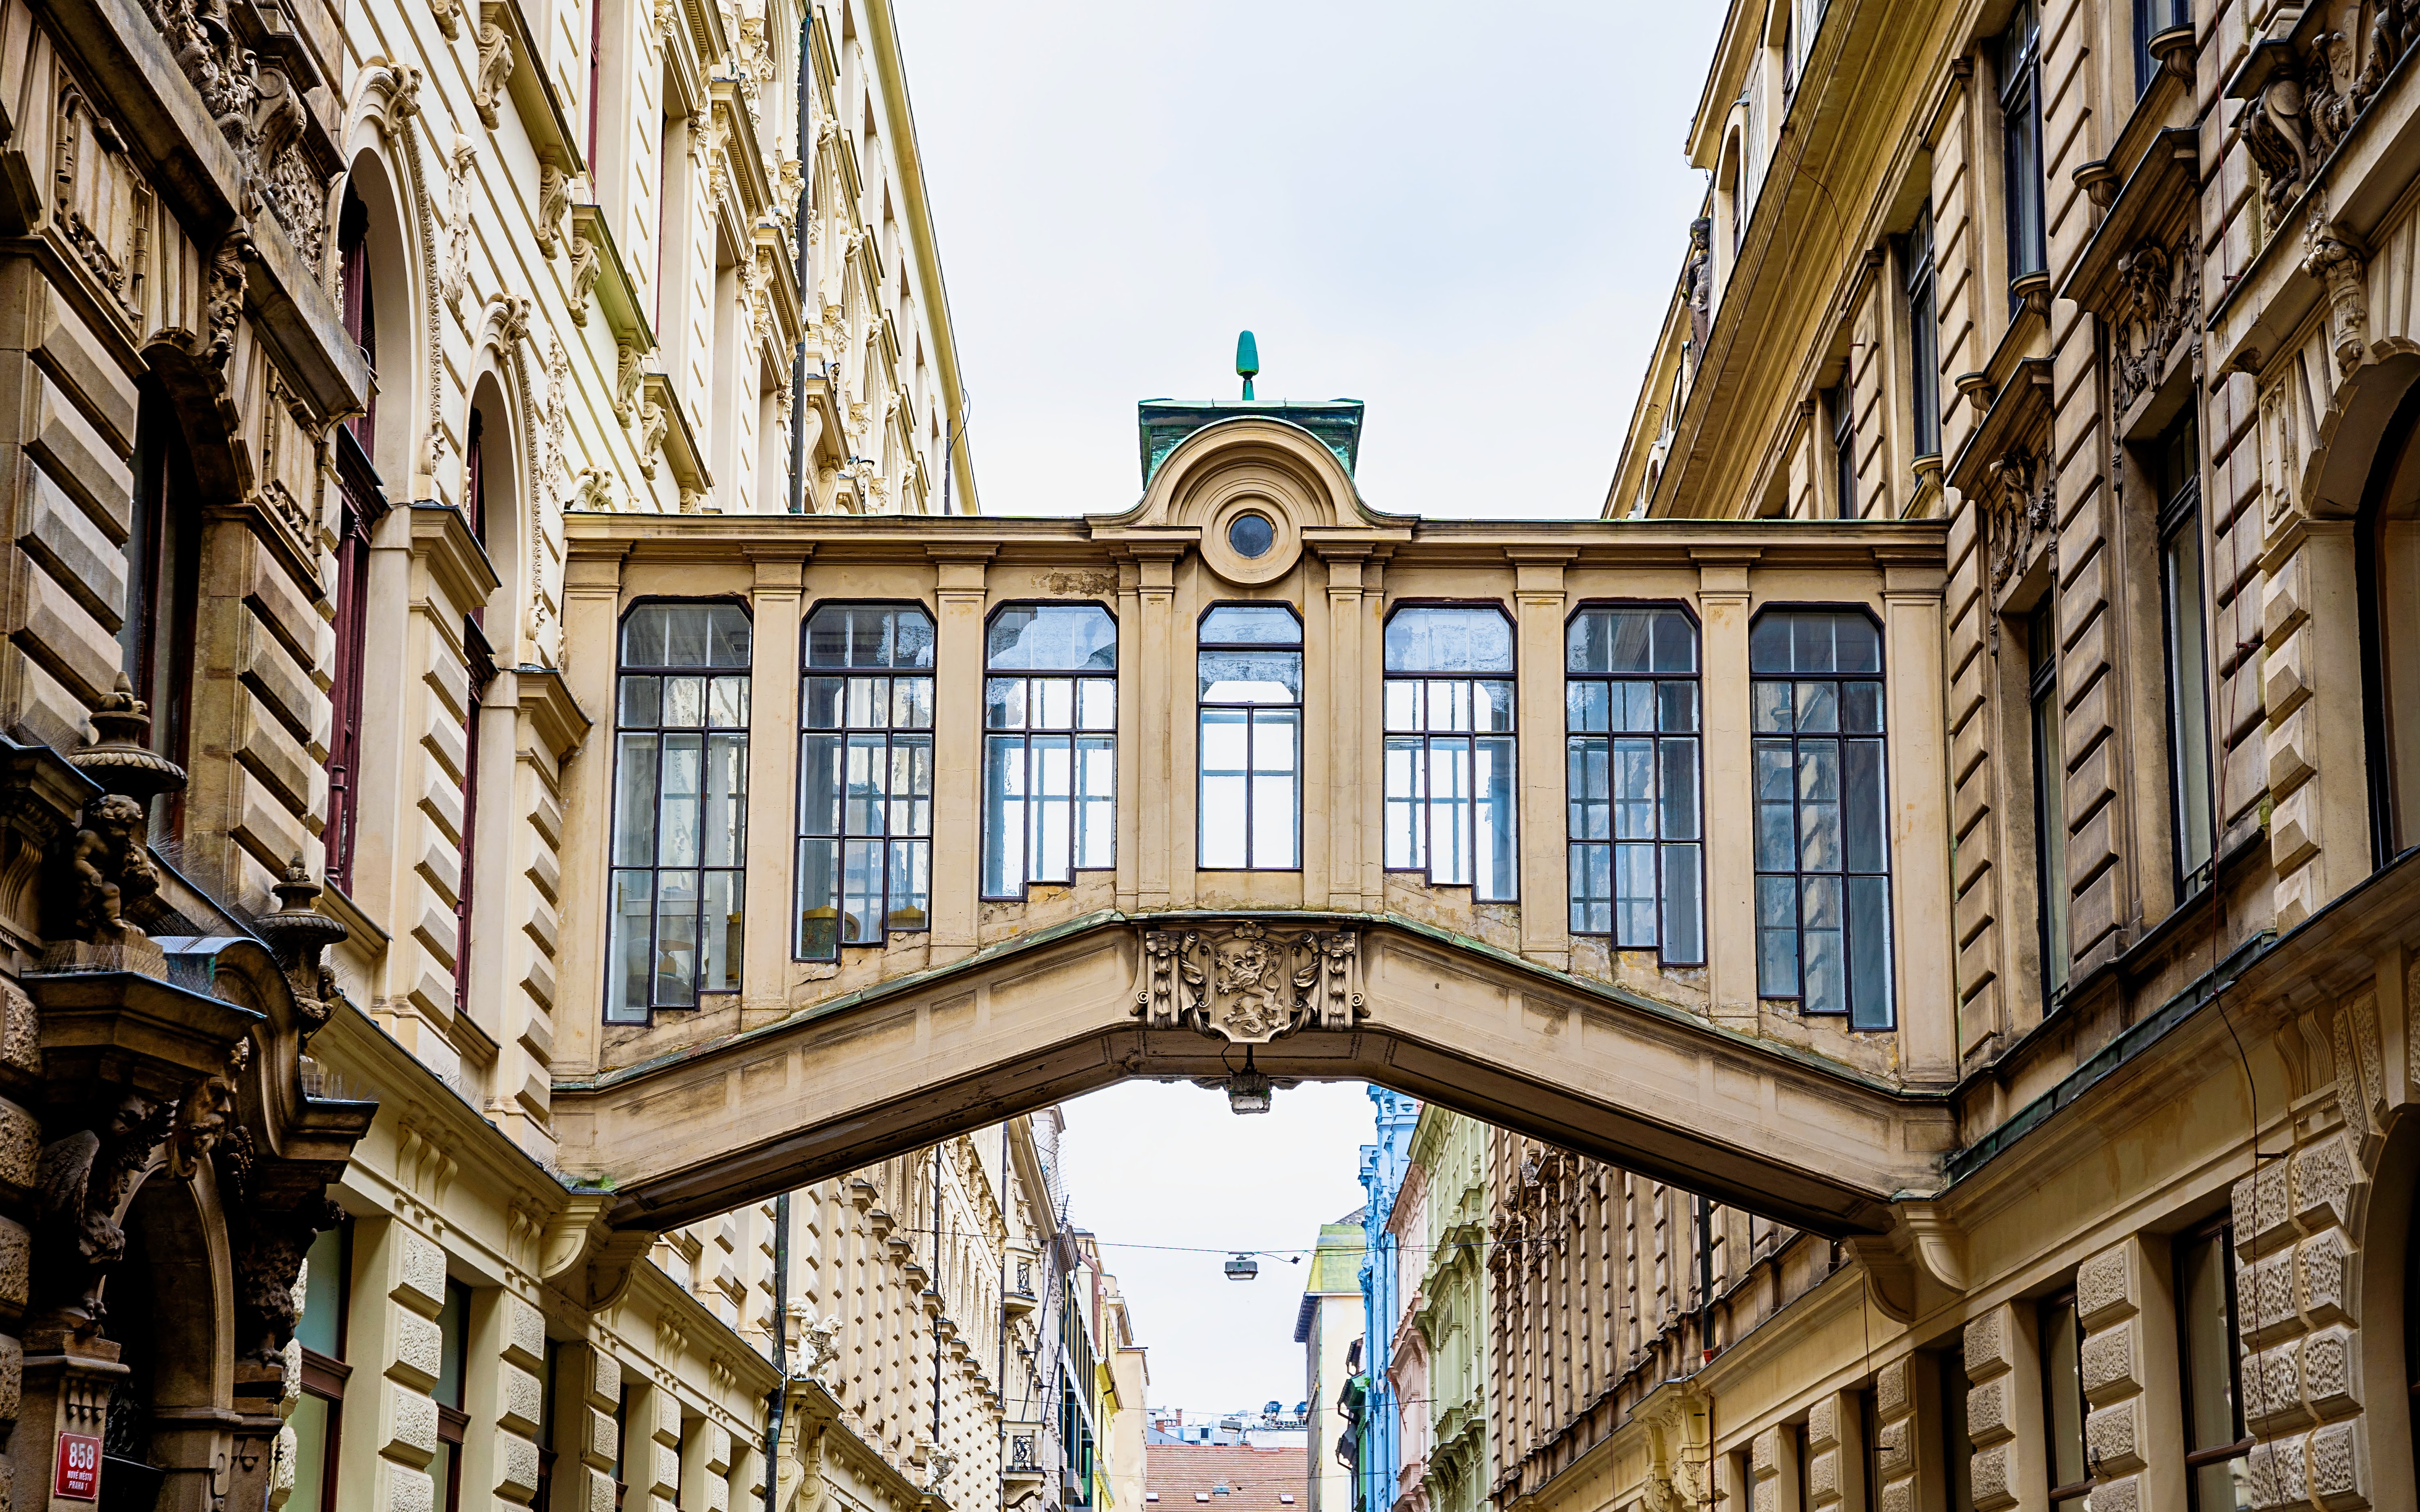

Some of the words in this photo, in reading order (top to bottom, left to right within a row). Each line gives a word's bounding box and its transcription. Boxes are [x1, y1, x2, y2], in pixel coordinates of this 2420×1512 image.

[69, 1442, 93, 1470] 858
[67, 1470, 79, 1479] NOVÉ
[68, 1481, 83, 1490] PRAHA
[85, 1483, 88, 1491] 1
